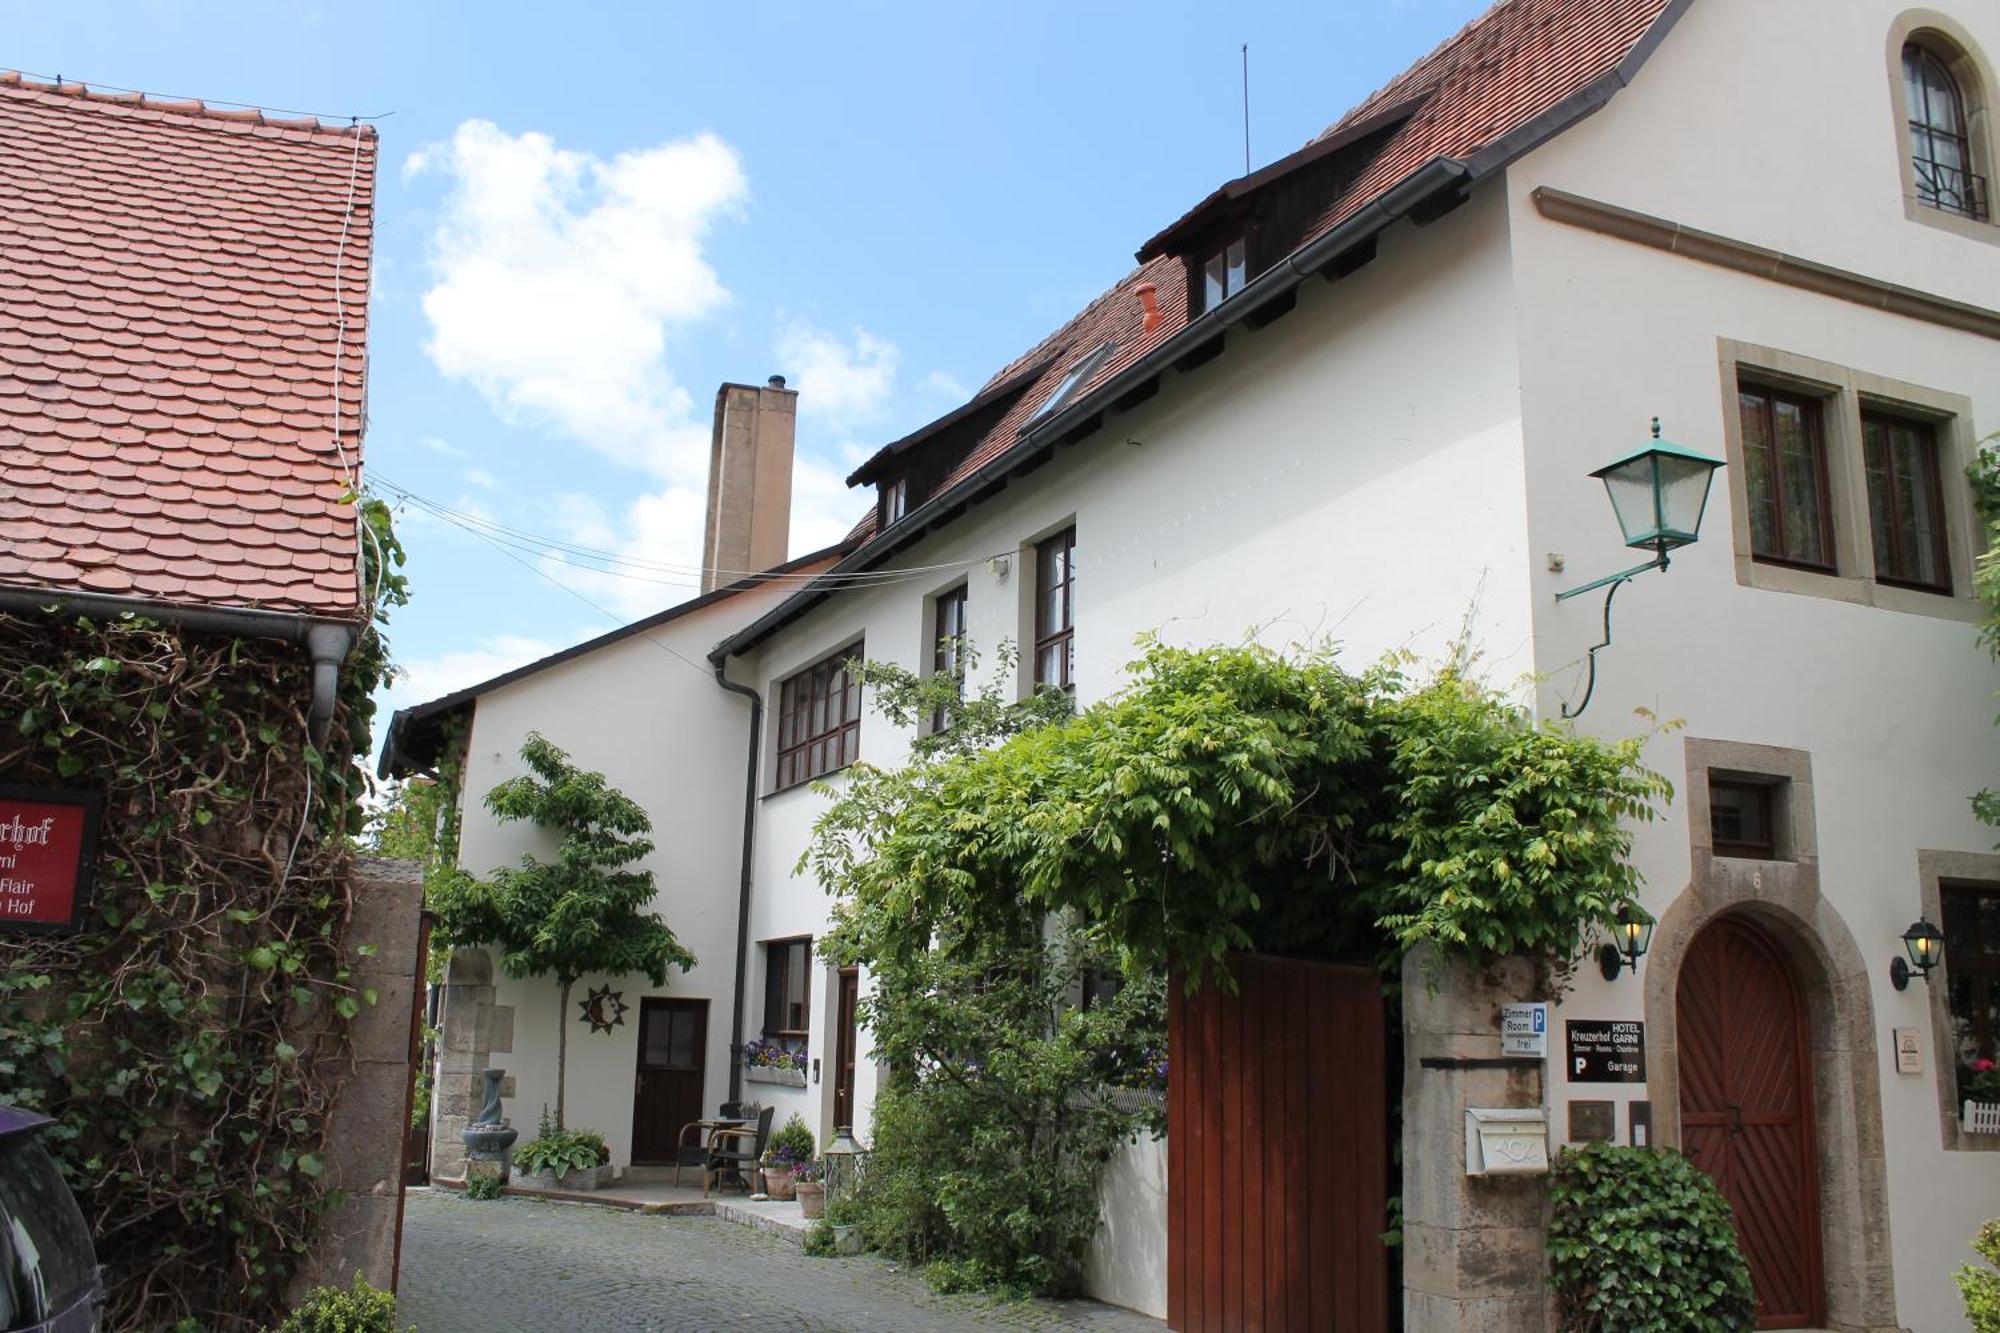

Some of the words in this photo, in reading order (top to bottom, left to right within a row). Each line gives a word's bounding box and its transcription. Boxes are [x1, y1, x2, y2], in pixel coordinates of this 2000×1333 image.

[0, 878, 35, 894] Flair
[7, 898, 36, 914] Hof
[1503, 1008, 1532, 1018] Zimmer
[1507, 1020, 1529, 1031] Room
[1612, 1023, 1640, 1033] HOTEL
[1571, 1030, 1610, 1041] Kreuzerhof
[1612, 1034, 1639, 1043] GARNI
[1575, 1057, 1587, 1074] P
[1607, 1061, 1638, 1074] Garage
